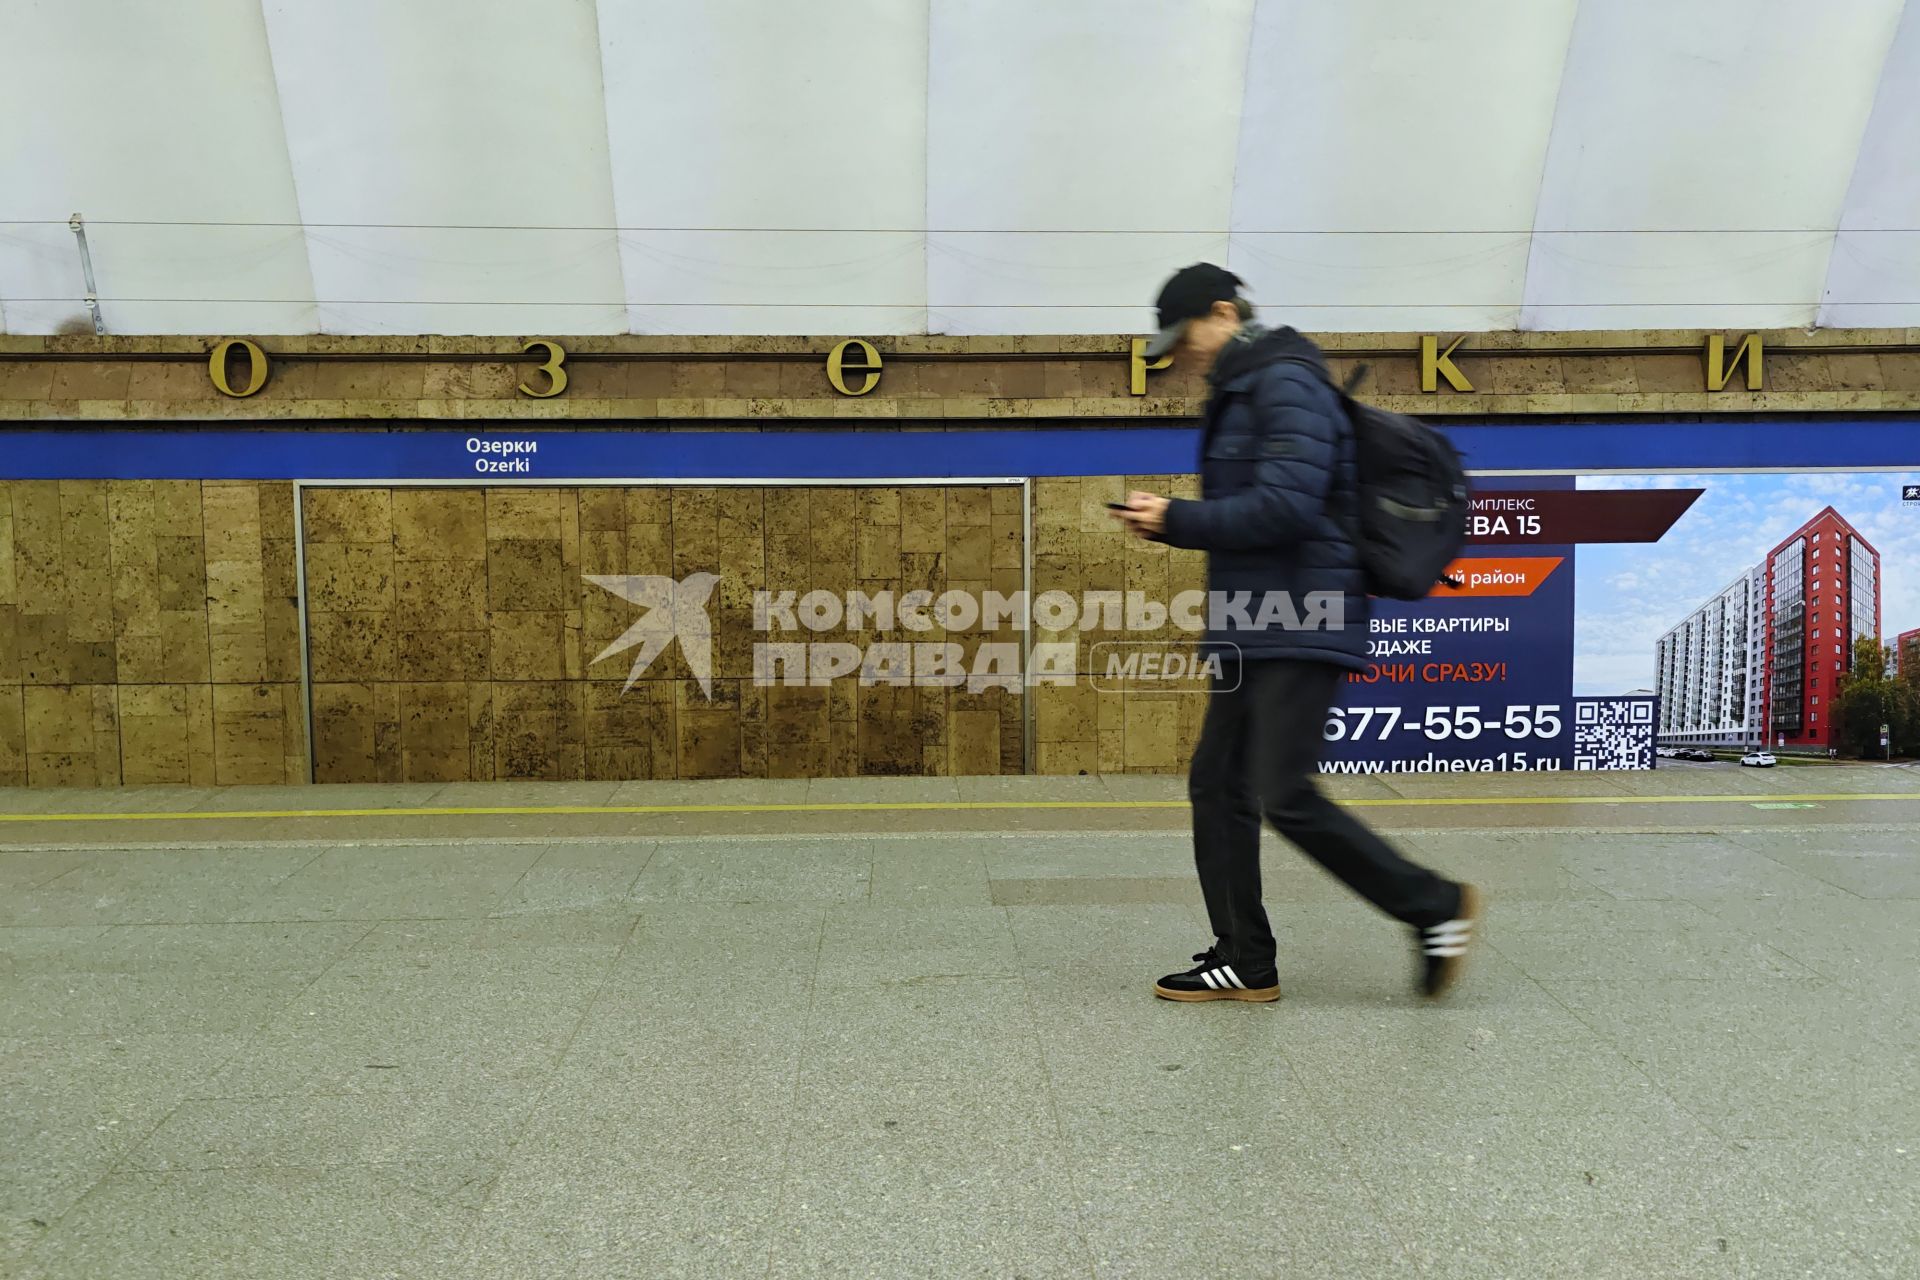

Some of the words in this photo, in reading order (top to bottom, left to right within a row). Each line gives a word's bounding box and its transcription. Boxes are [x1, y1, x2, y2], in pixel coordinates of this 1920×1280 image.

[466, 437, 537, 457] Озерки
[475, 457, 530, 472] Ozerki
[1516, 515, 1541, 535] 15
[1470, 569, 1525, 588] район
[1370, 618, 1408, 633] ВЫЕ
[1412, 617, 1510, 633] КВАРТИРЫ
[1422, 662, 1506, 682] СРАЗУ!
[1323, 704, 1562, 741] 677-55-55
[1317, 752, 1561, 774] www.rudneva15.ru
